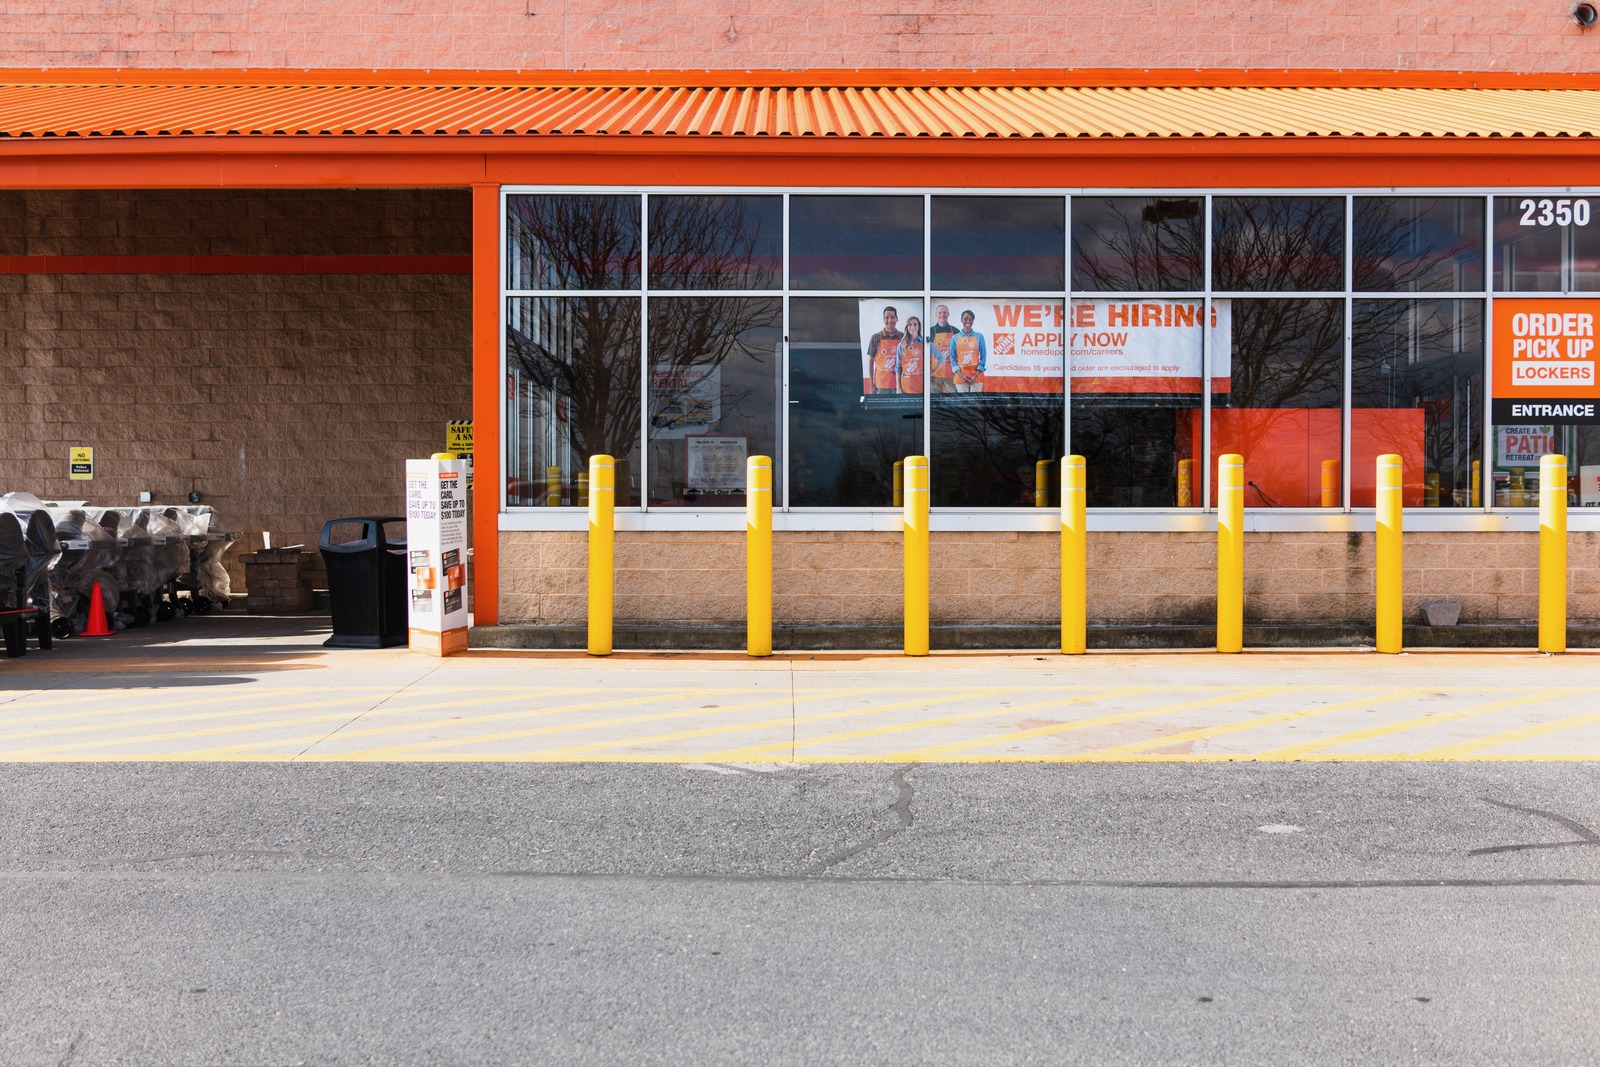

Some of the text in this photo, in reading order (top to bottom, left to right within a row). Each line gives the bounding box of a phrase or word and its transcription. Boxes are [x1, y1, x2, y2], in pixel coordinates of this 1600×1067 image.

[1519, 199, 1590, 226] 2350
[993, 304, 1216, 328] WE'RE HIRING
[1512, 312, 1593, 337] ORDER
[1021, 332, 1128, 347] APPLY NOW
[1513, 338, 1594, 358] PICK UP
[680, 370, 705, 378] TRUCK
[1516, 367, 1591, 379] LOCKERS
[651, 378, 688, 388] RENTAL
[1512, 404, 1594, 417] ENTRANCE
[418, 480, 427, 489] THE
[440, 480, 458, 489] GET THE
[440, 490, 453, 500] CARD,
[409, 500, 436, 509] SAVE UP TO
[440, 499, 465, 509] SAVE UP TO
[409, 510, 436, 519] $100 TODAY
[440, 509, 465, 520] $100 TODAY
